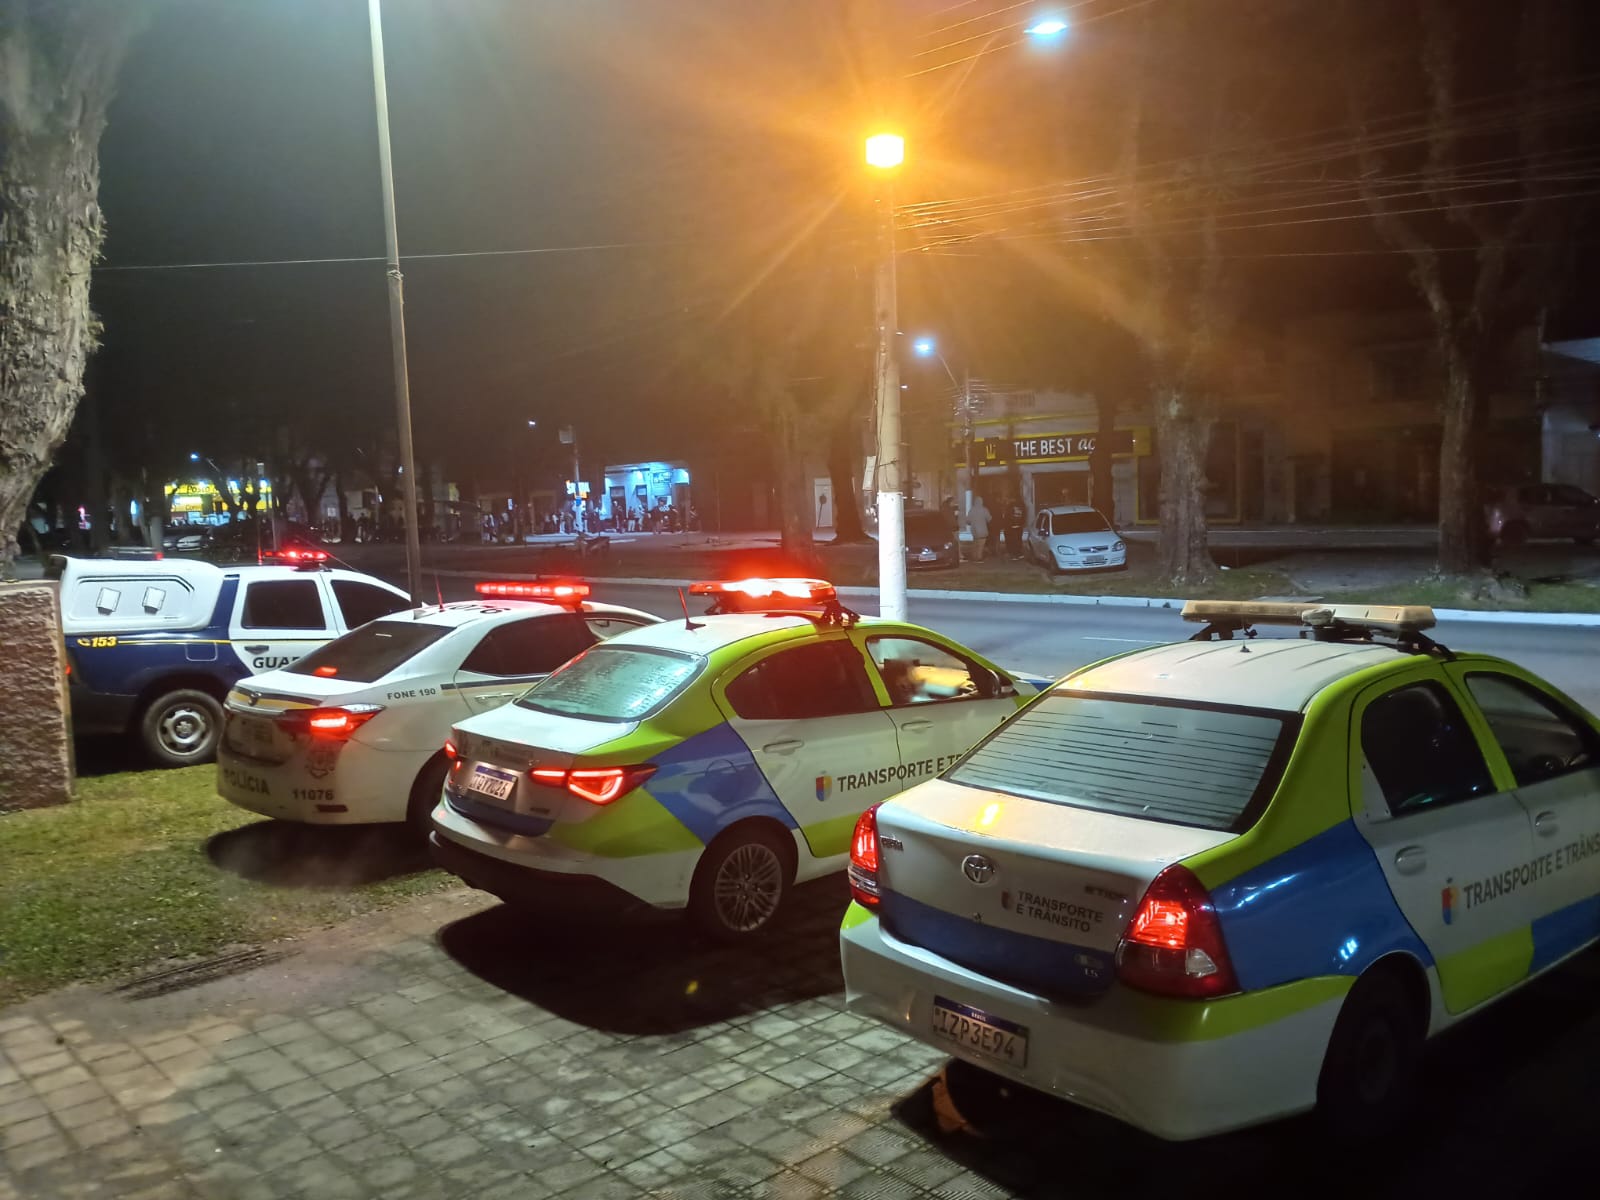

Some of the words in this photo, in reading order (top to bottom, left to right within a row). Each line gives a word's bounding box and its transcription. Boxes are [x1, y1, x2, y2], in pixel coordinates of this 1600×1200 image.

[1013, 439, 1037, 457] THE
[1040, 437, 1073, 456] BEST
[91, 636, 118, 648] 153
[387, 689, 417, 700] FONE
[419, 687, 437, 697] 190
[837, 758, 934, 793] TRANSPORTE
[936, 756, 945, 772] E
[292, 788, 335, 801] 11076
[1463, 852, 1553, 910] TRANSPORTE
[1555, 848, 1563, 870] E
[1016, 903, 1024, 915] E
[1018, 890, 1105, 923] TRANSPORTE
[938, 1010, 1015, 1059] IZP3E94
